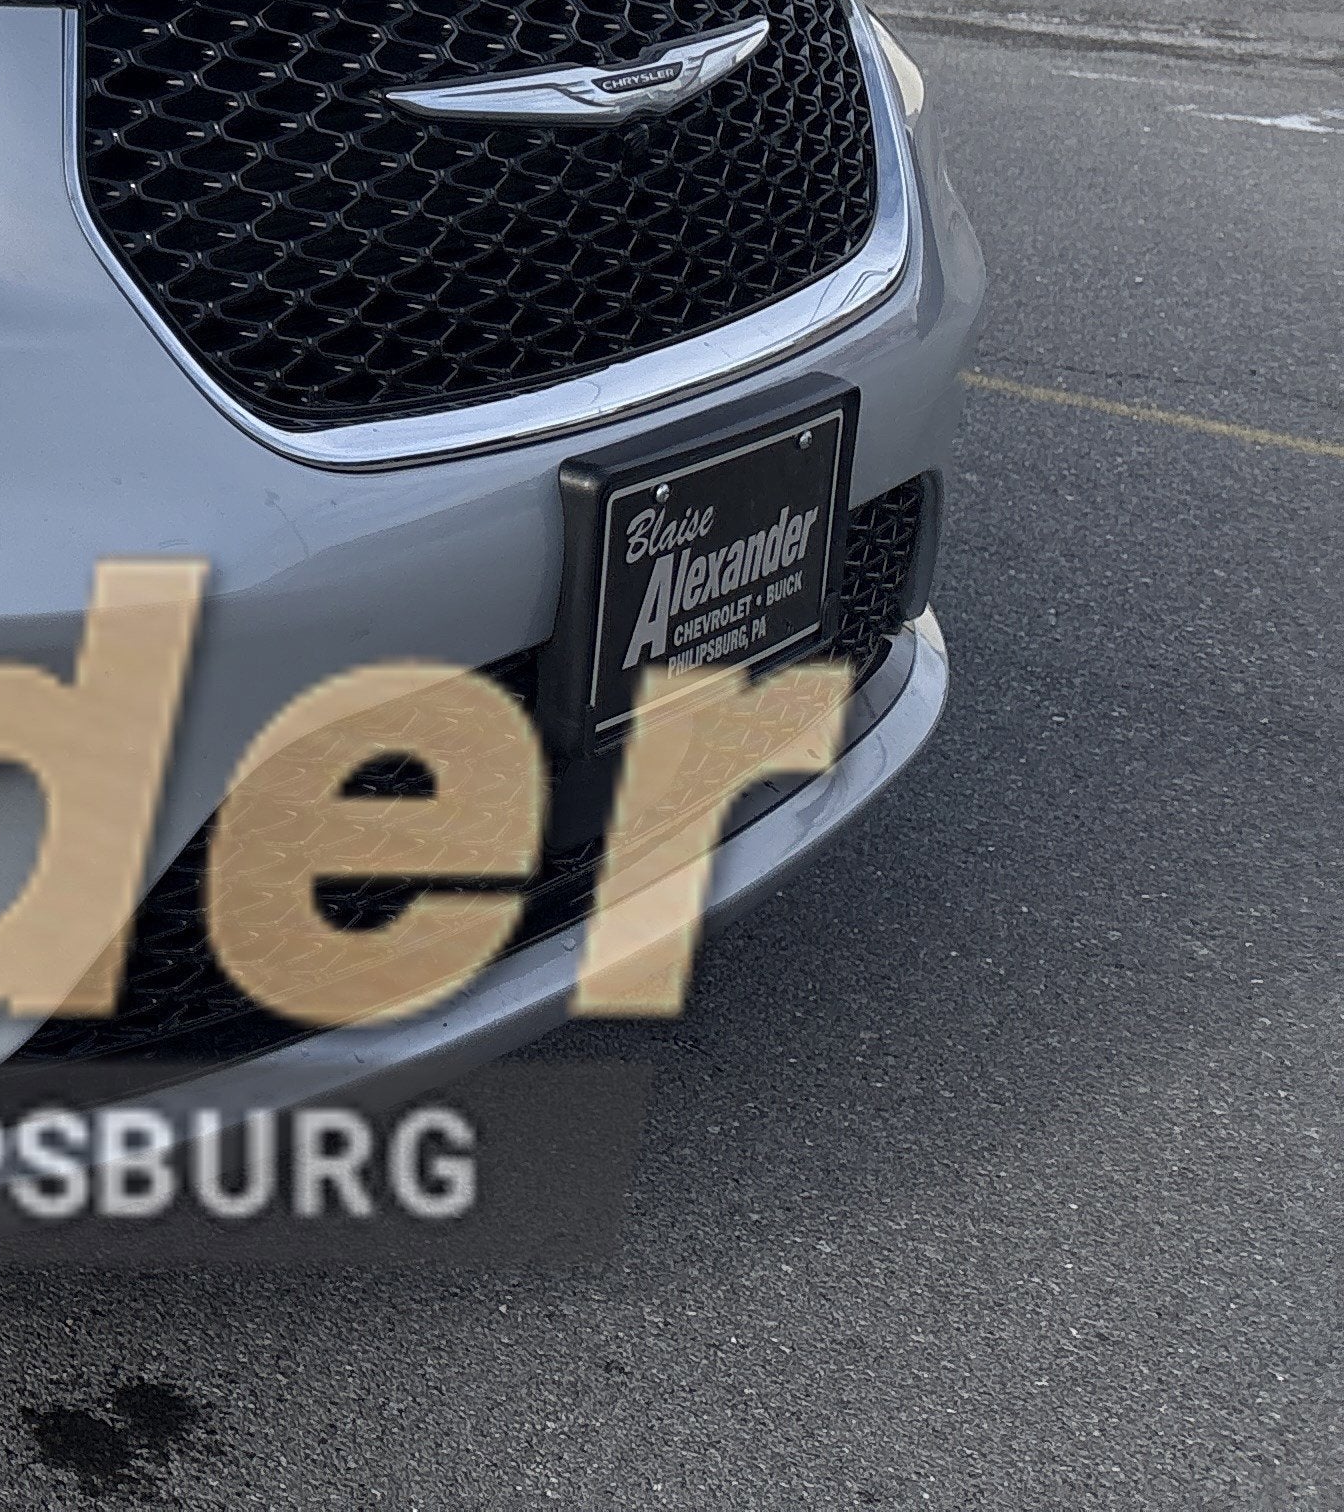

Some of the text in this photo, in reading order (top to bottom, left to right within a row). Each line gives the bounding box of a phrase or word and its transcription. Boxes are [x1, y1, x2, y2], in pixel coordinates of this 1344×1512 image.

[602, 68, 675, 91] CHRYSLER
[625, 505, 715, 564] Blaise
[622, 505, 820, 670] Alexander
[673, 569, 803, 647] CHEVROLET BUICK
[751, 614, 767, 644] PA
